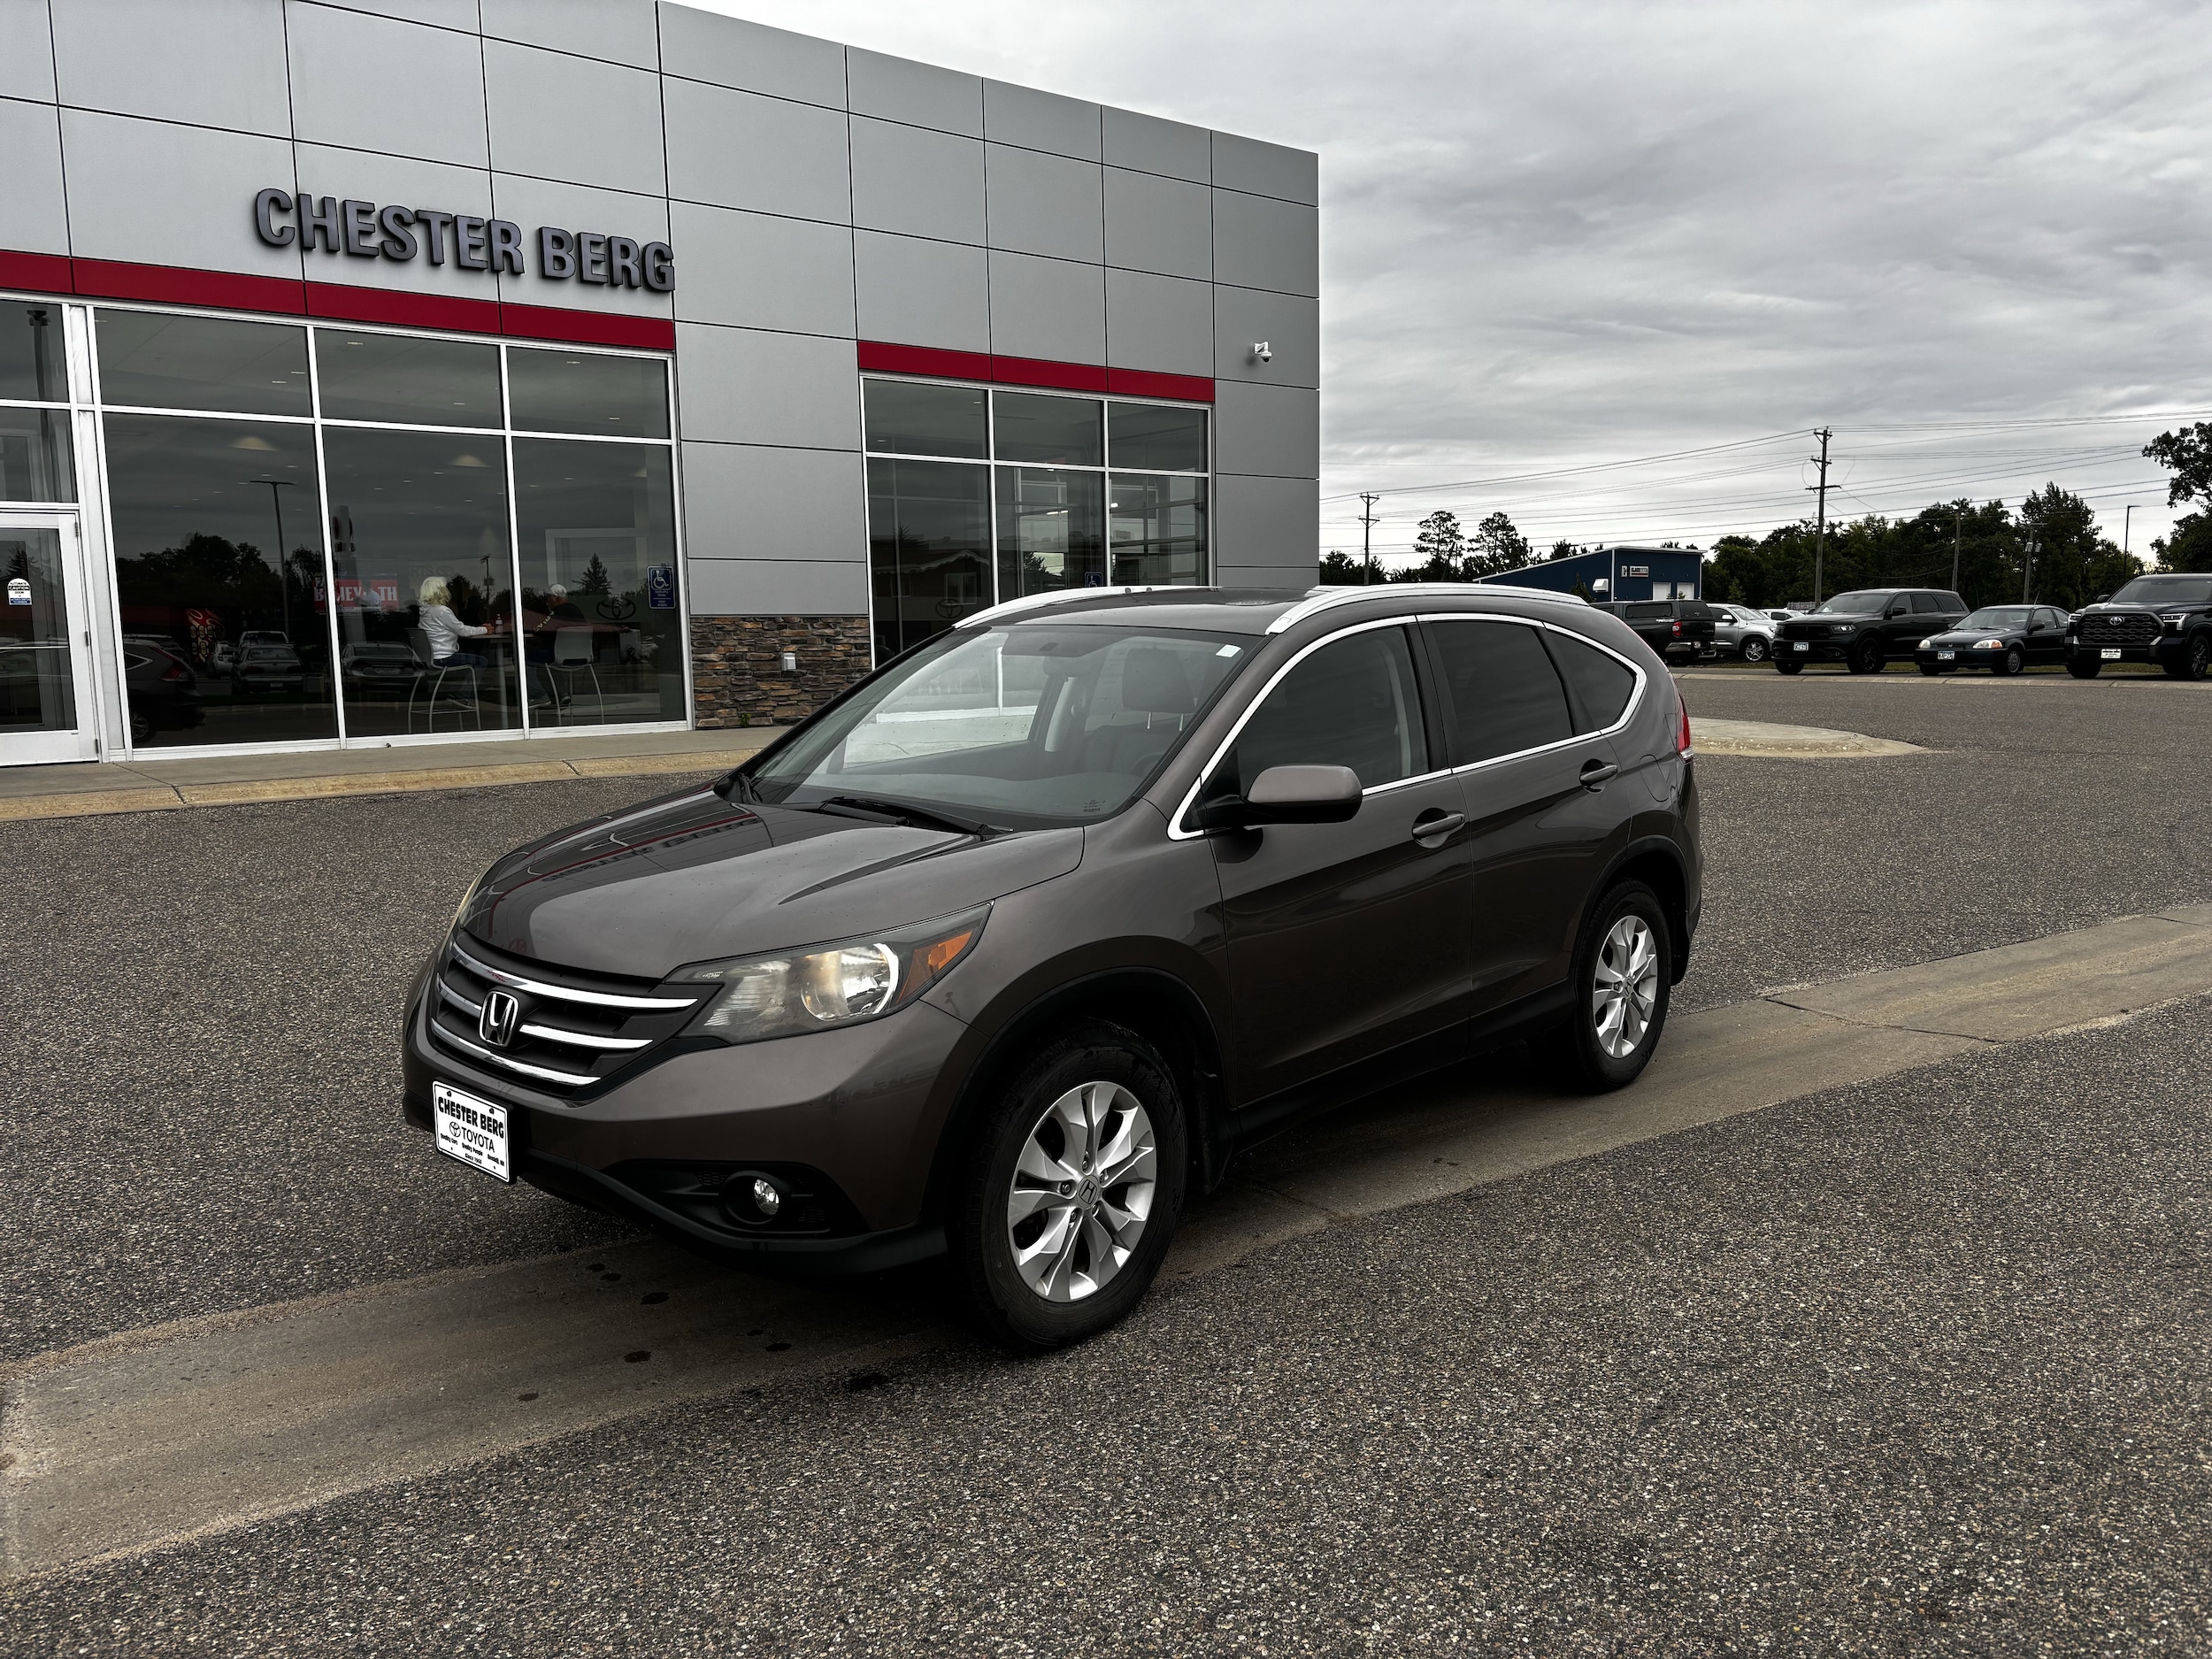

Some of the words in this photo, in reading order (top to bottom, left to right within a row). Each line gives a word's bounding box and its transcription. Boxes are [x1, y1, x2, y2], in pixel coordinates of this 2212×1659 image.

[255, 188, 525, 273] CHESTER
[539, 226, 675, 292] BERG
[438, 1096, 478, 1127] CHESTER
[480, 1113, 503, 1139] BERG
[461, 1126, 495, 1153] TOYOTA
